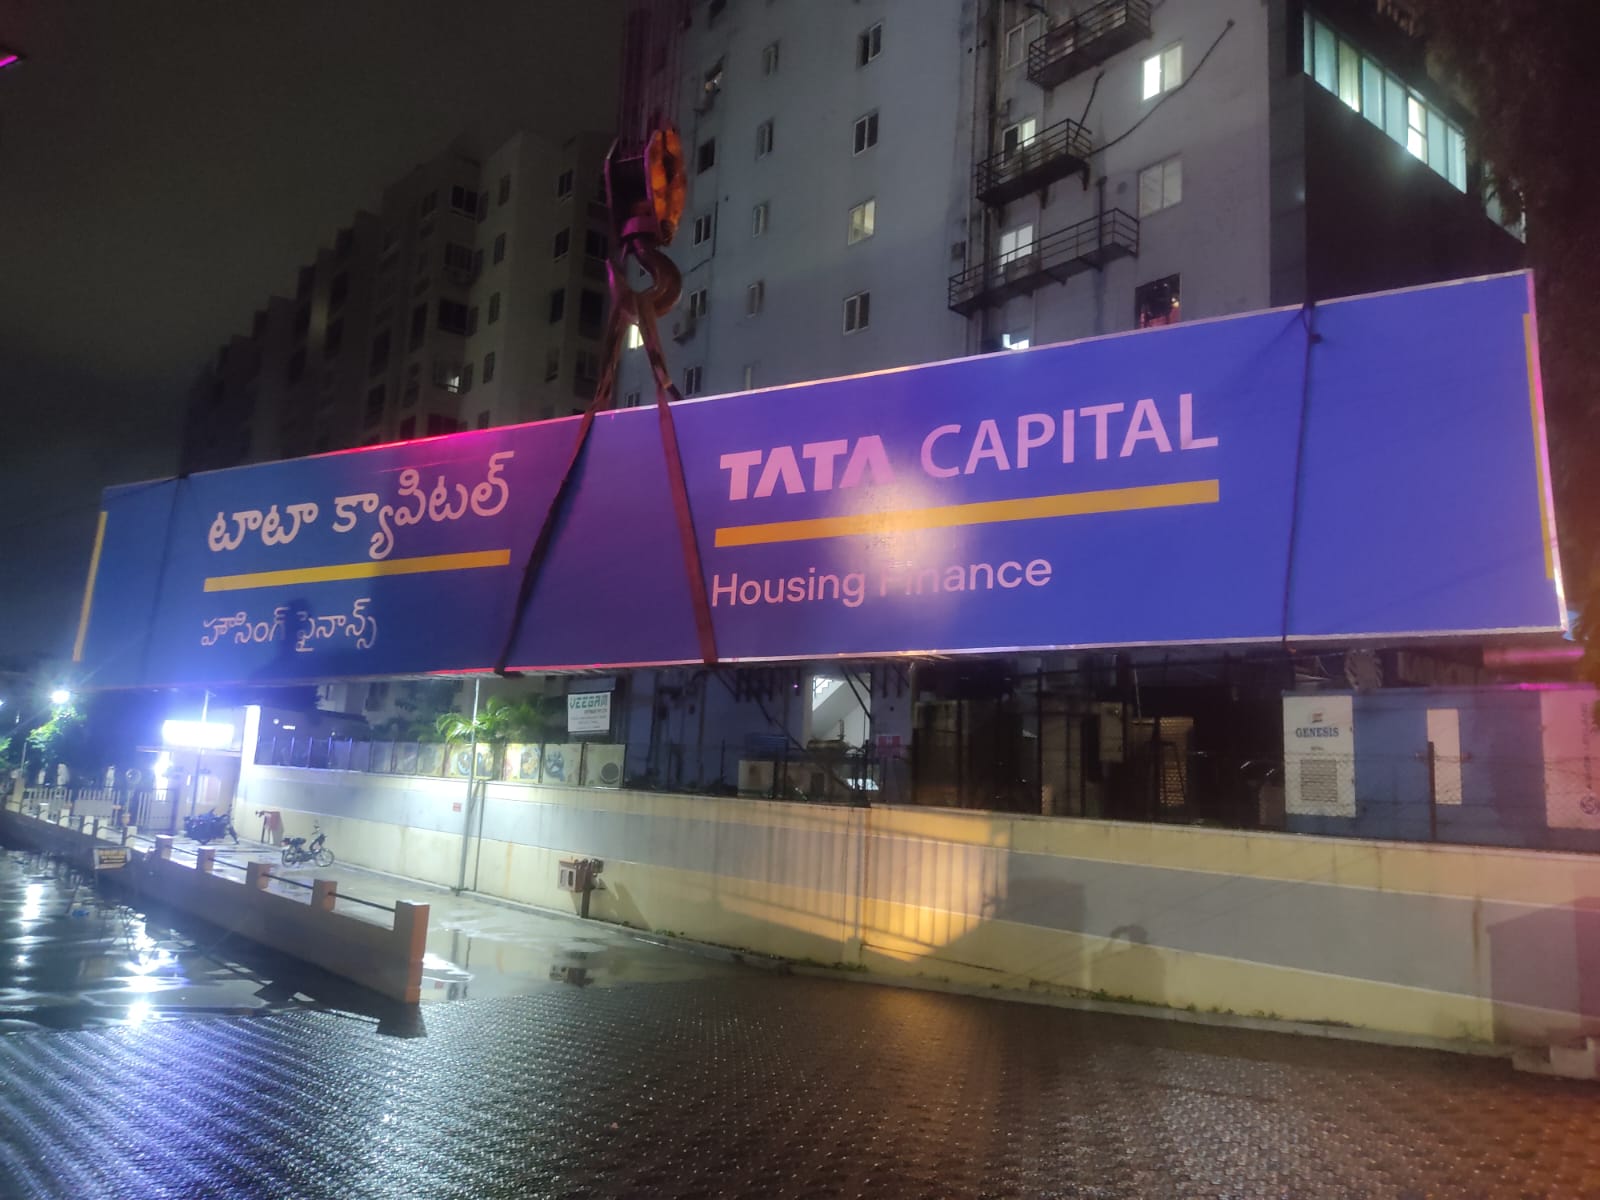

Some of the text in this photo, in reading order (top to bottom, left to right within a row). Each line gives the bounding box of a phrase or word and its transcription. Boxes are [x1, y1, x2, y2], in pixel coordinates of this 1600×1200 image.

[718, 393, 1218, 501] TATA CAPITAL
[207, 450, 515, 560] టాటా క్యాపిటల్
[711, 558, 1052, 608] Housing Finance
[1295, 727, 1340, 738] GENESIS
